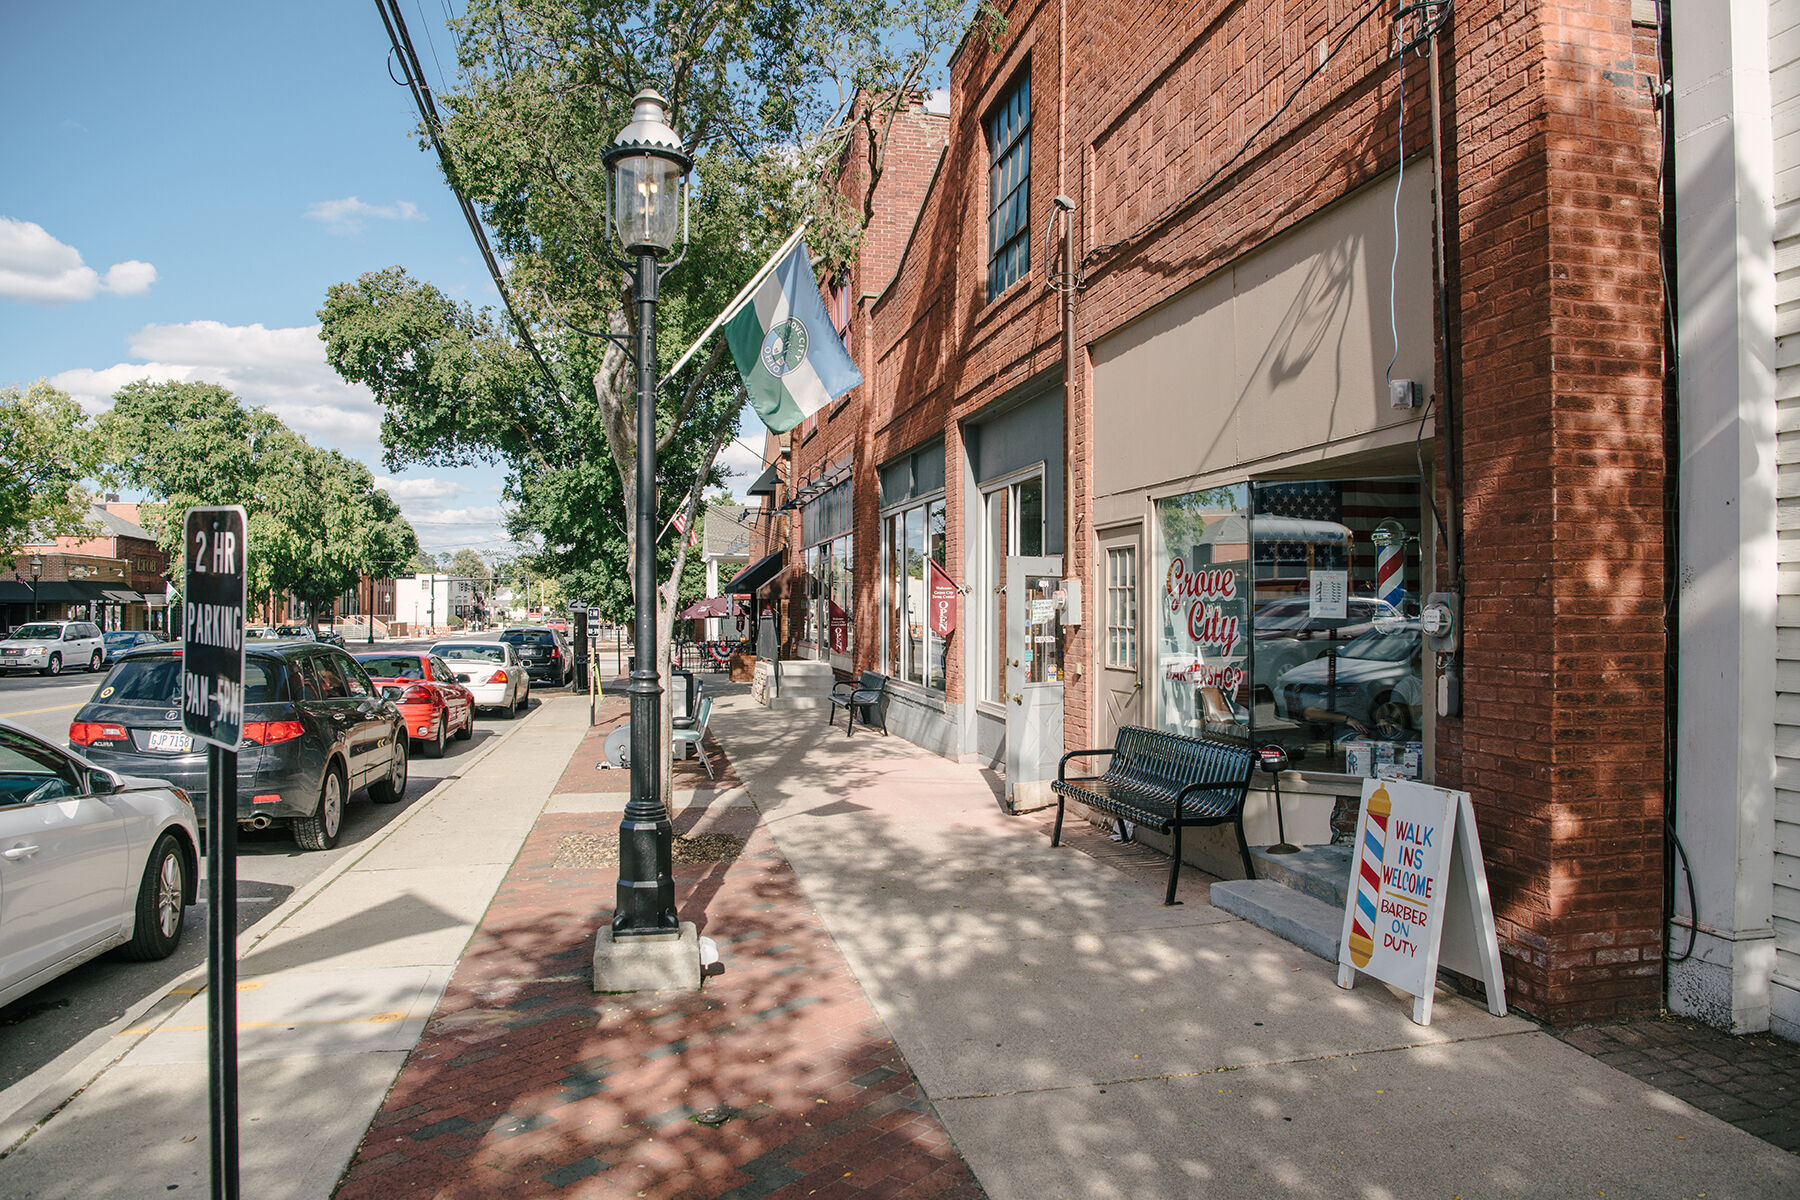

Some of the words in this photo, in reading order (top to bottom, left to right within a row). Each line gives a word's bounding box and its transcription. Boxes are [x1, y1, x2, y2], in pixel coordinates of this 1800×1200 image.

[764, 346, 780, 373] OHIO
[795, 337, 805, 361] CITY
[195, 531, 206, 573] 2
[213, 531, 236, 574] HR
[1166, 558, 1235, 611] Grove
[187, 602, 242, 651] PARKING
[938, 600, 949, 632] OPEN
[1188, 600, 1239, 657] City
[151, 733, 167, 746] GJP
[169, 735, 190, 748] 7158
[1396, 819, 1434, 848] WALK
[1398, 845, 1424, 870] INS
[1383, 864, 1434, 899] WELCOME
[1380, 898, 1428, 928] BARBER
[1391, 919, 1410, 938] ON
[1383, 933, 1418, 958] DUTY
